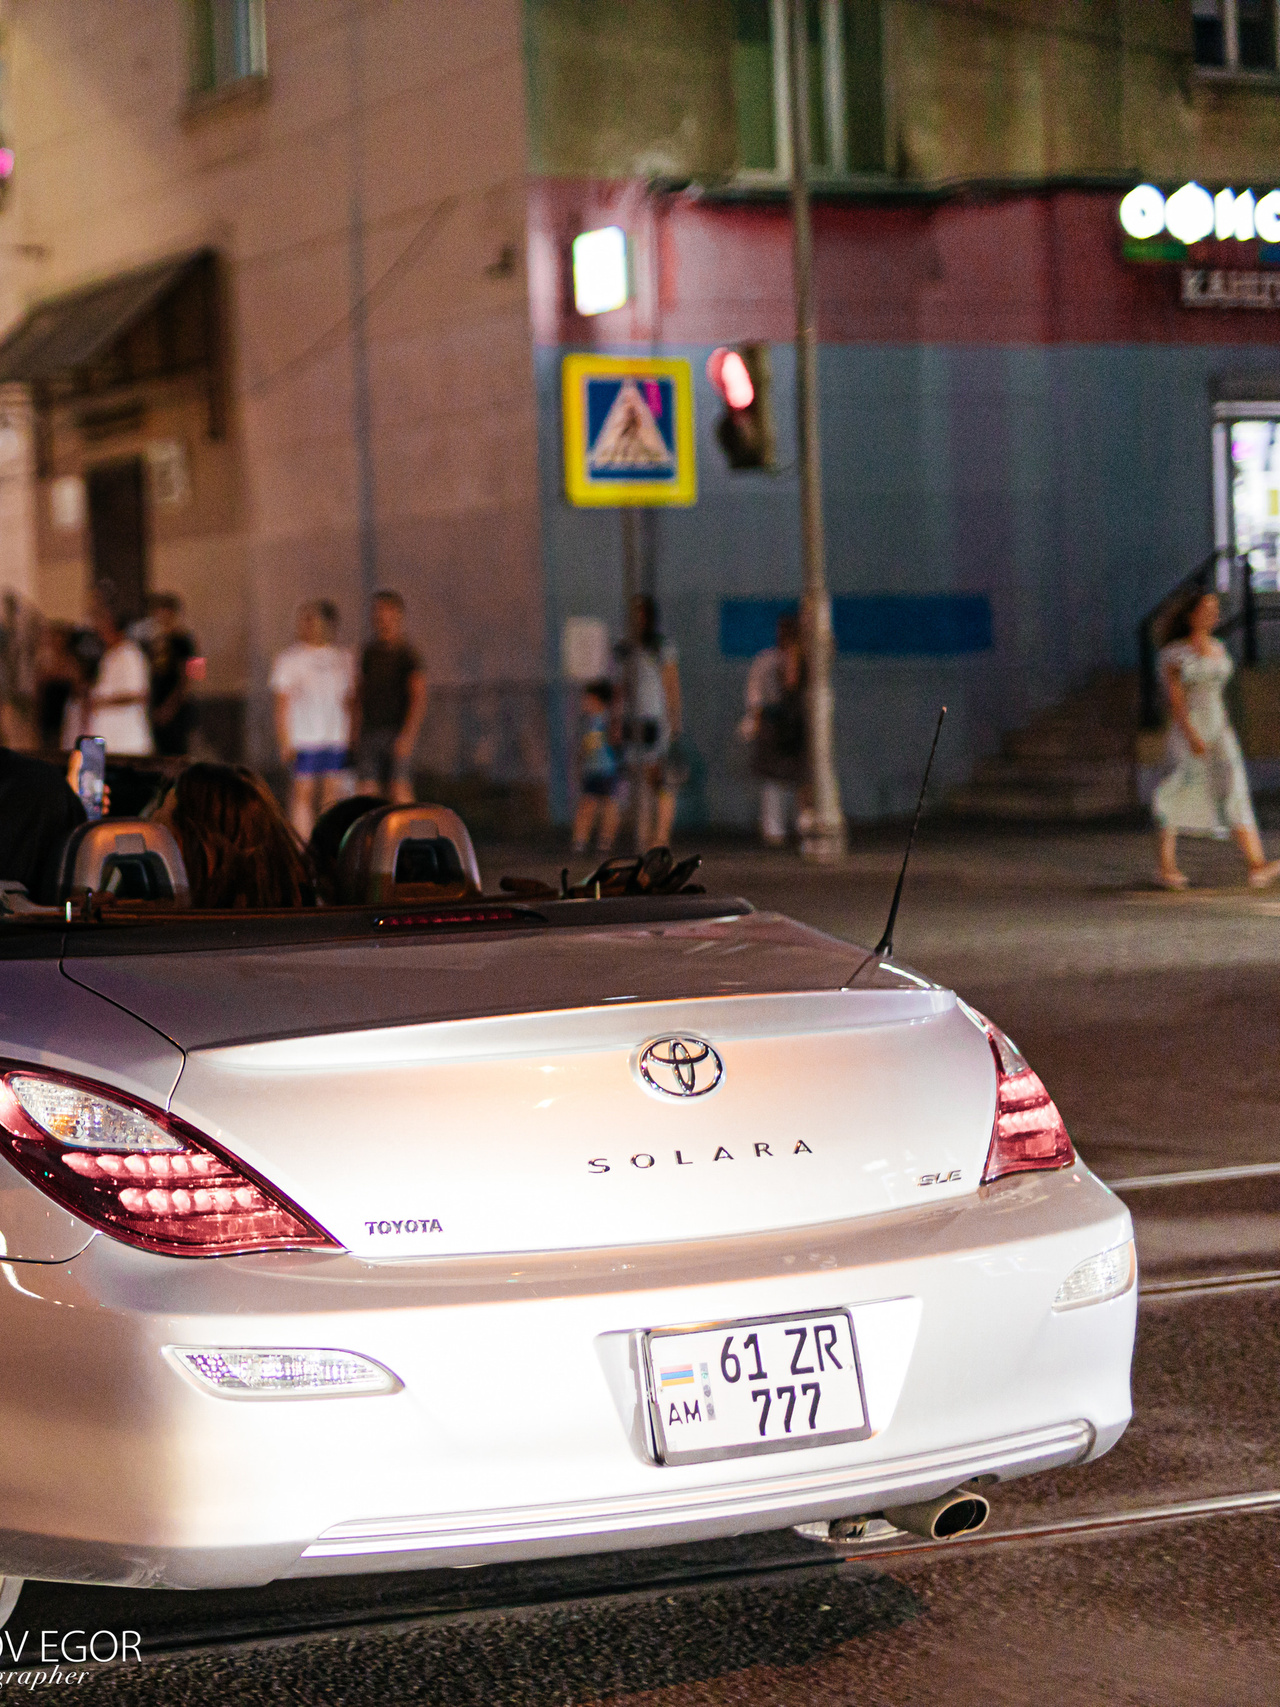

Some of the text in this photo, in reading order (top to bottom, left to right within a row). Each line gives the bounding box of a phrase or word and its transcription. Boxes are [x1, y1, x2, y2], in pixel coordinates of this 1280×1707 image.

[587, 1139, 814, 1174] SOLARA
[917, 1169, 962, 1187] SLE
[364, 1218, 444, 1236] TOYOTA
[720, 1323, 844, 1384] 61 ZR
[668, 1399, 702, 1426] AM
[751, 1381, 821, 1437] 777
